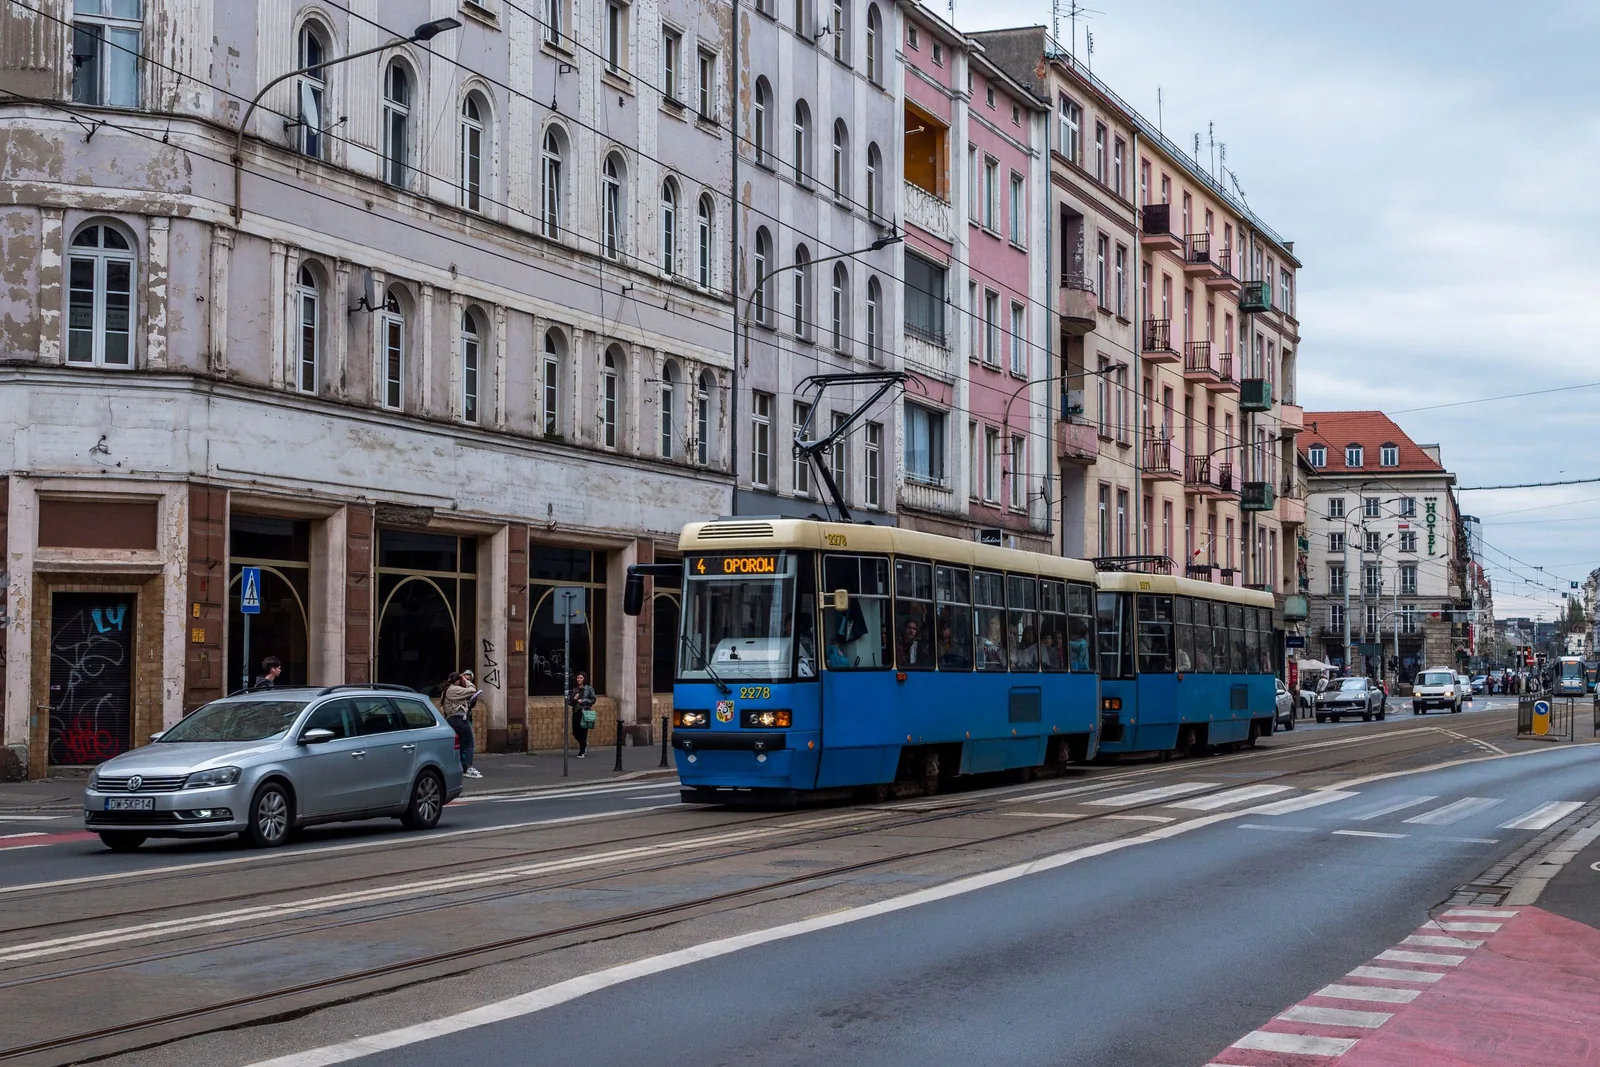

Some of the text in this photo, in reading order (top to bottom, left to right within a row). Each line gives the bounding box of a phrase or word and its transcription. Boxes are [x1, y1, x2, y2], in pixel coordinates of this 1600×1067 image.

[107, 312, 127, 320] KSW
[1425, 502, 1436, 556] HOTEL
[697, 558, 706, 574] 4
[740, 686, 771, 700] 2278
[110, 799, 121, 809] DW
